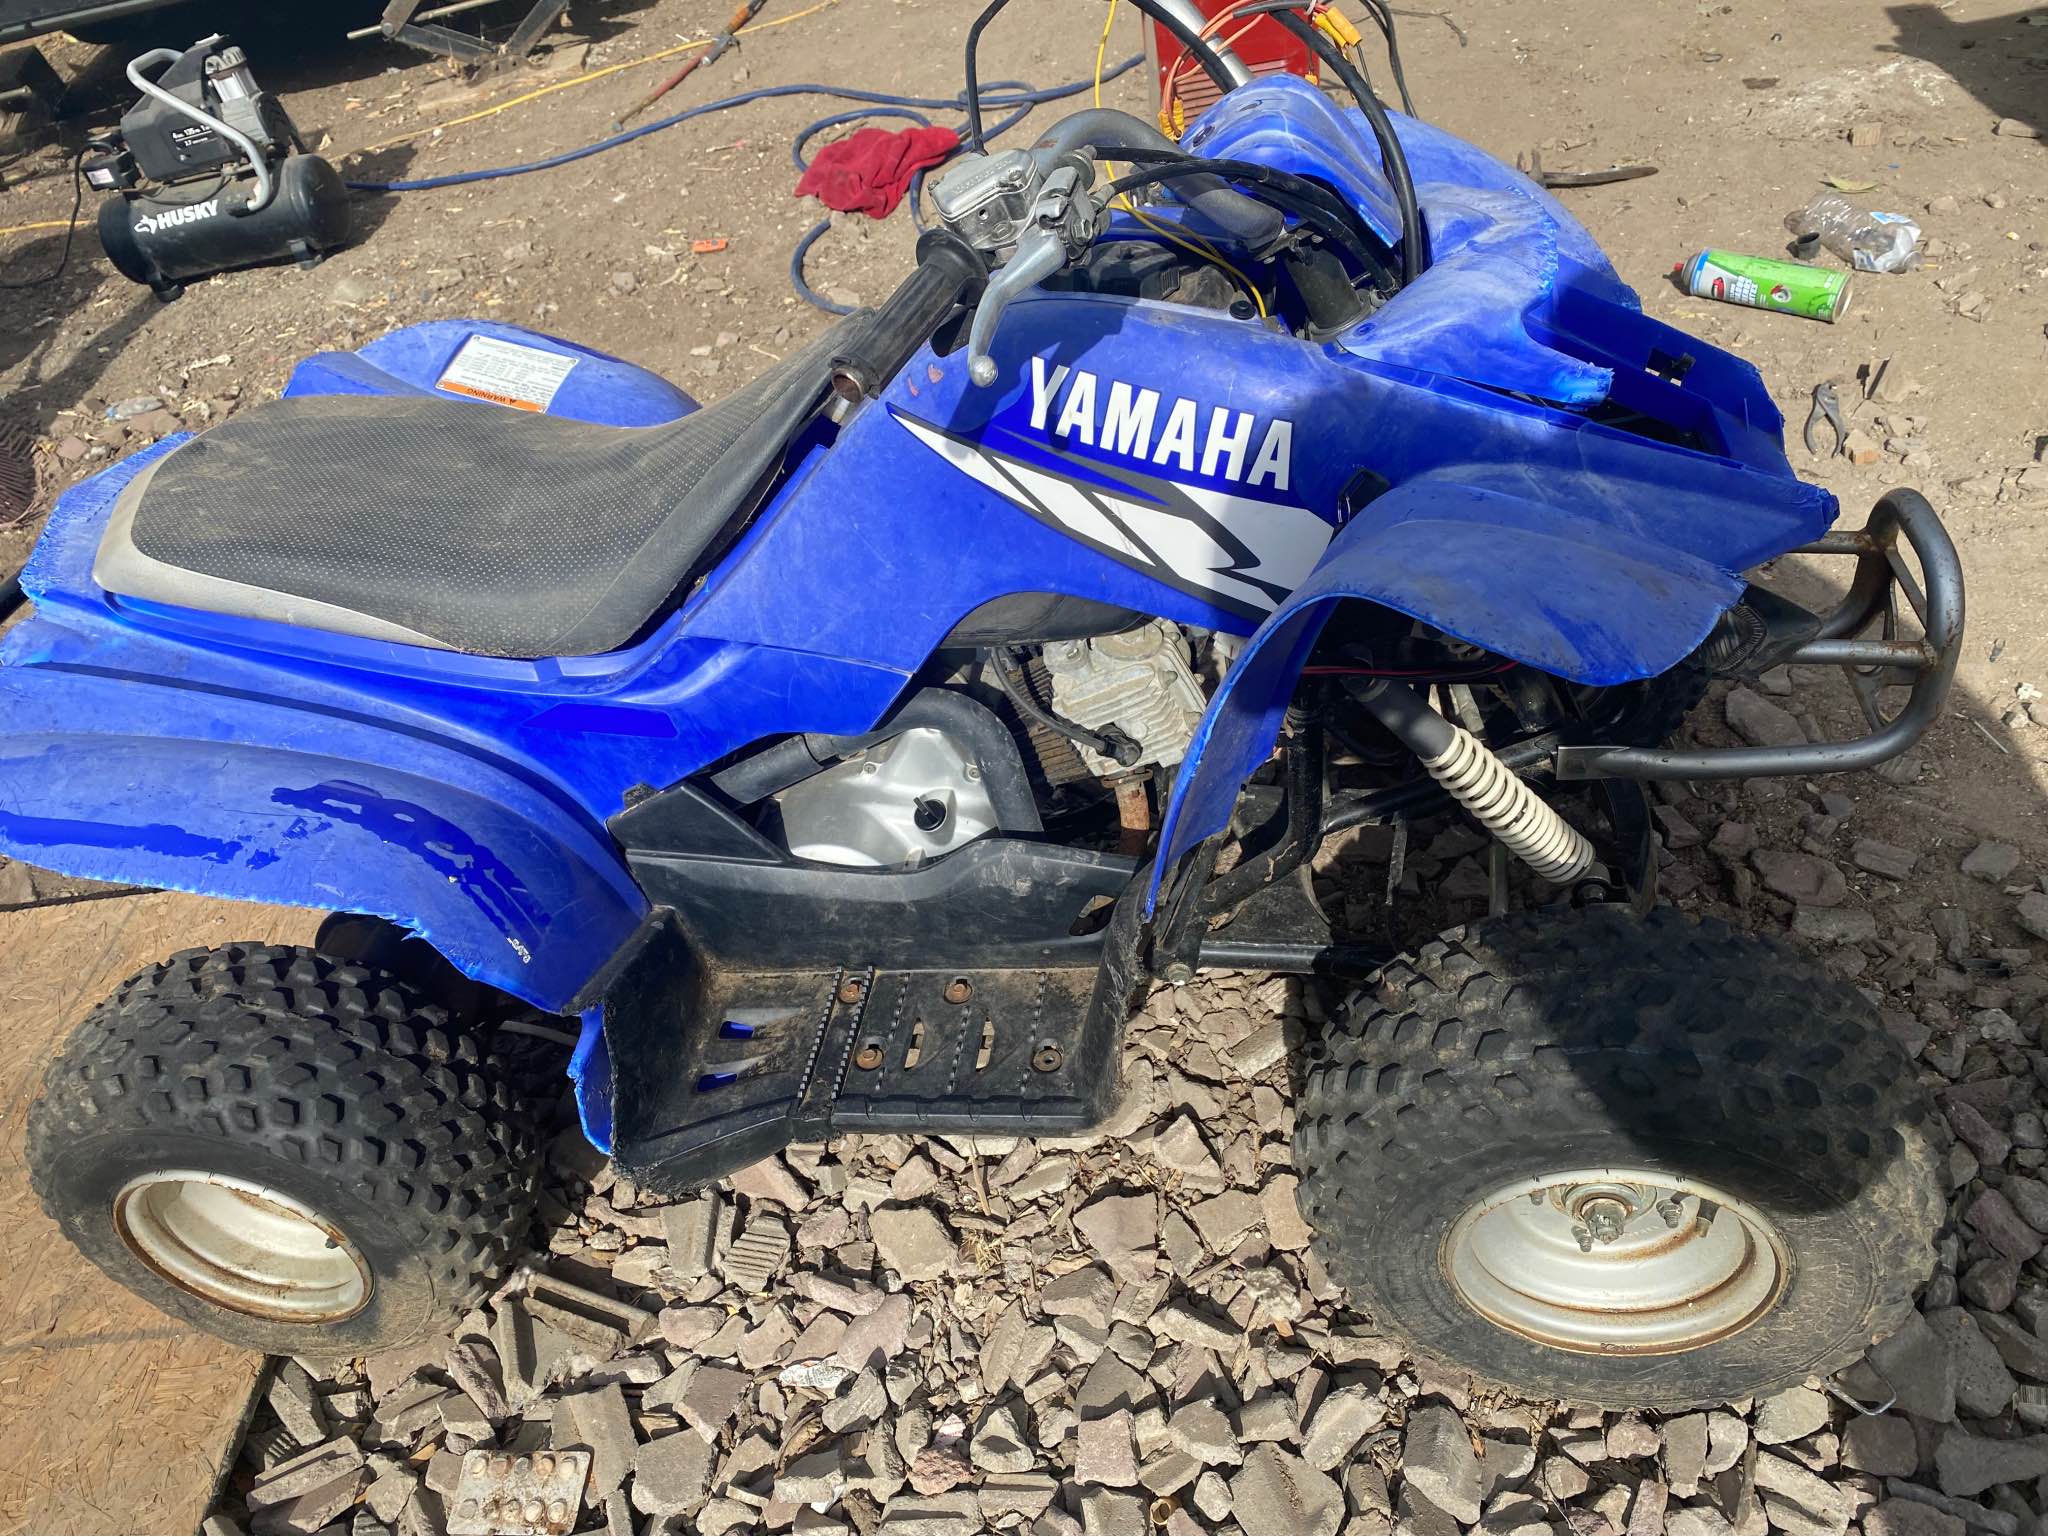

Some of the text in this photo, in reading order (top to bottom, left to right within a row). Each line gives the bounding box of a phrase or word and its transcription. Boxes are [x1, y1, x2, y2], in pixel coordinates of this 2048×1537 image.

[156, 199, 218, 230] HUSKY
[466, 388, 506, 403] WARNING
[1030, 356, 1294, 491] YAMAHA
